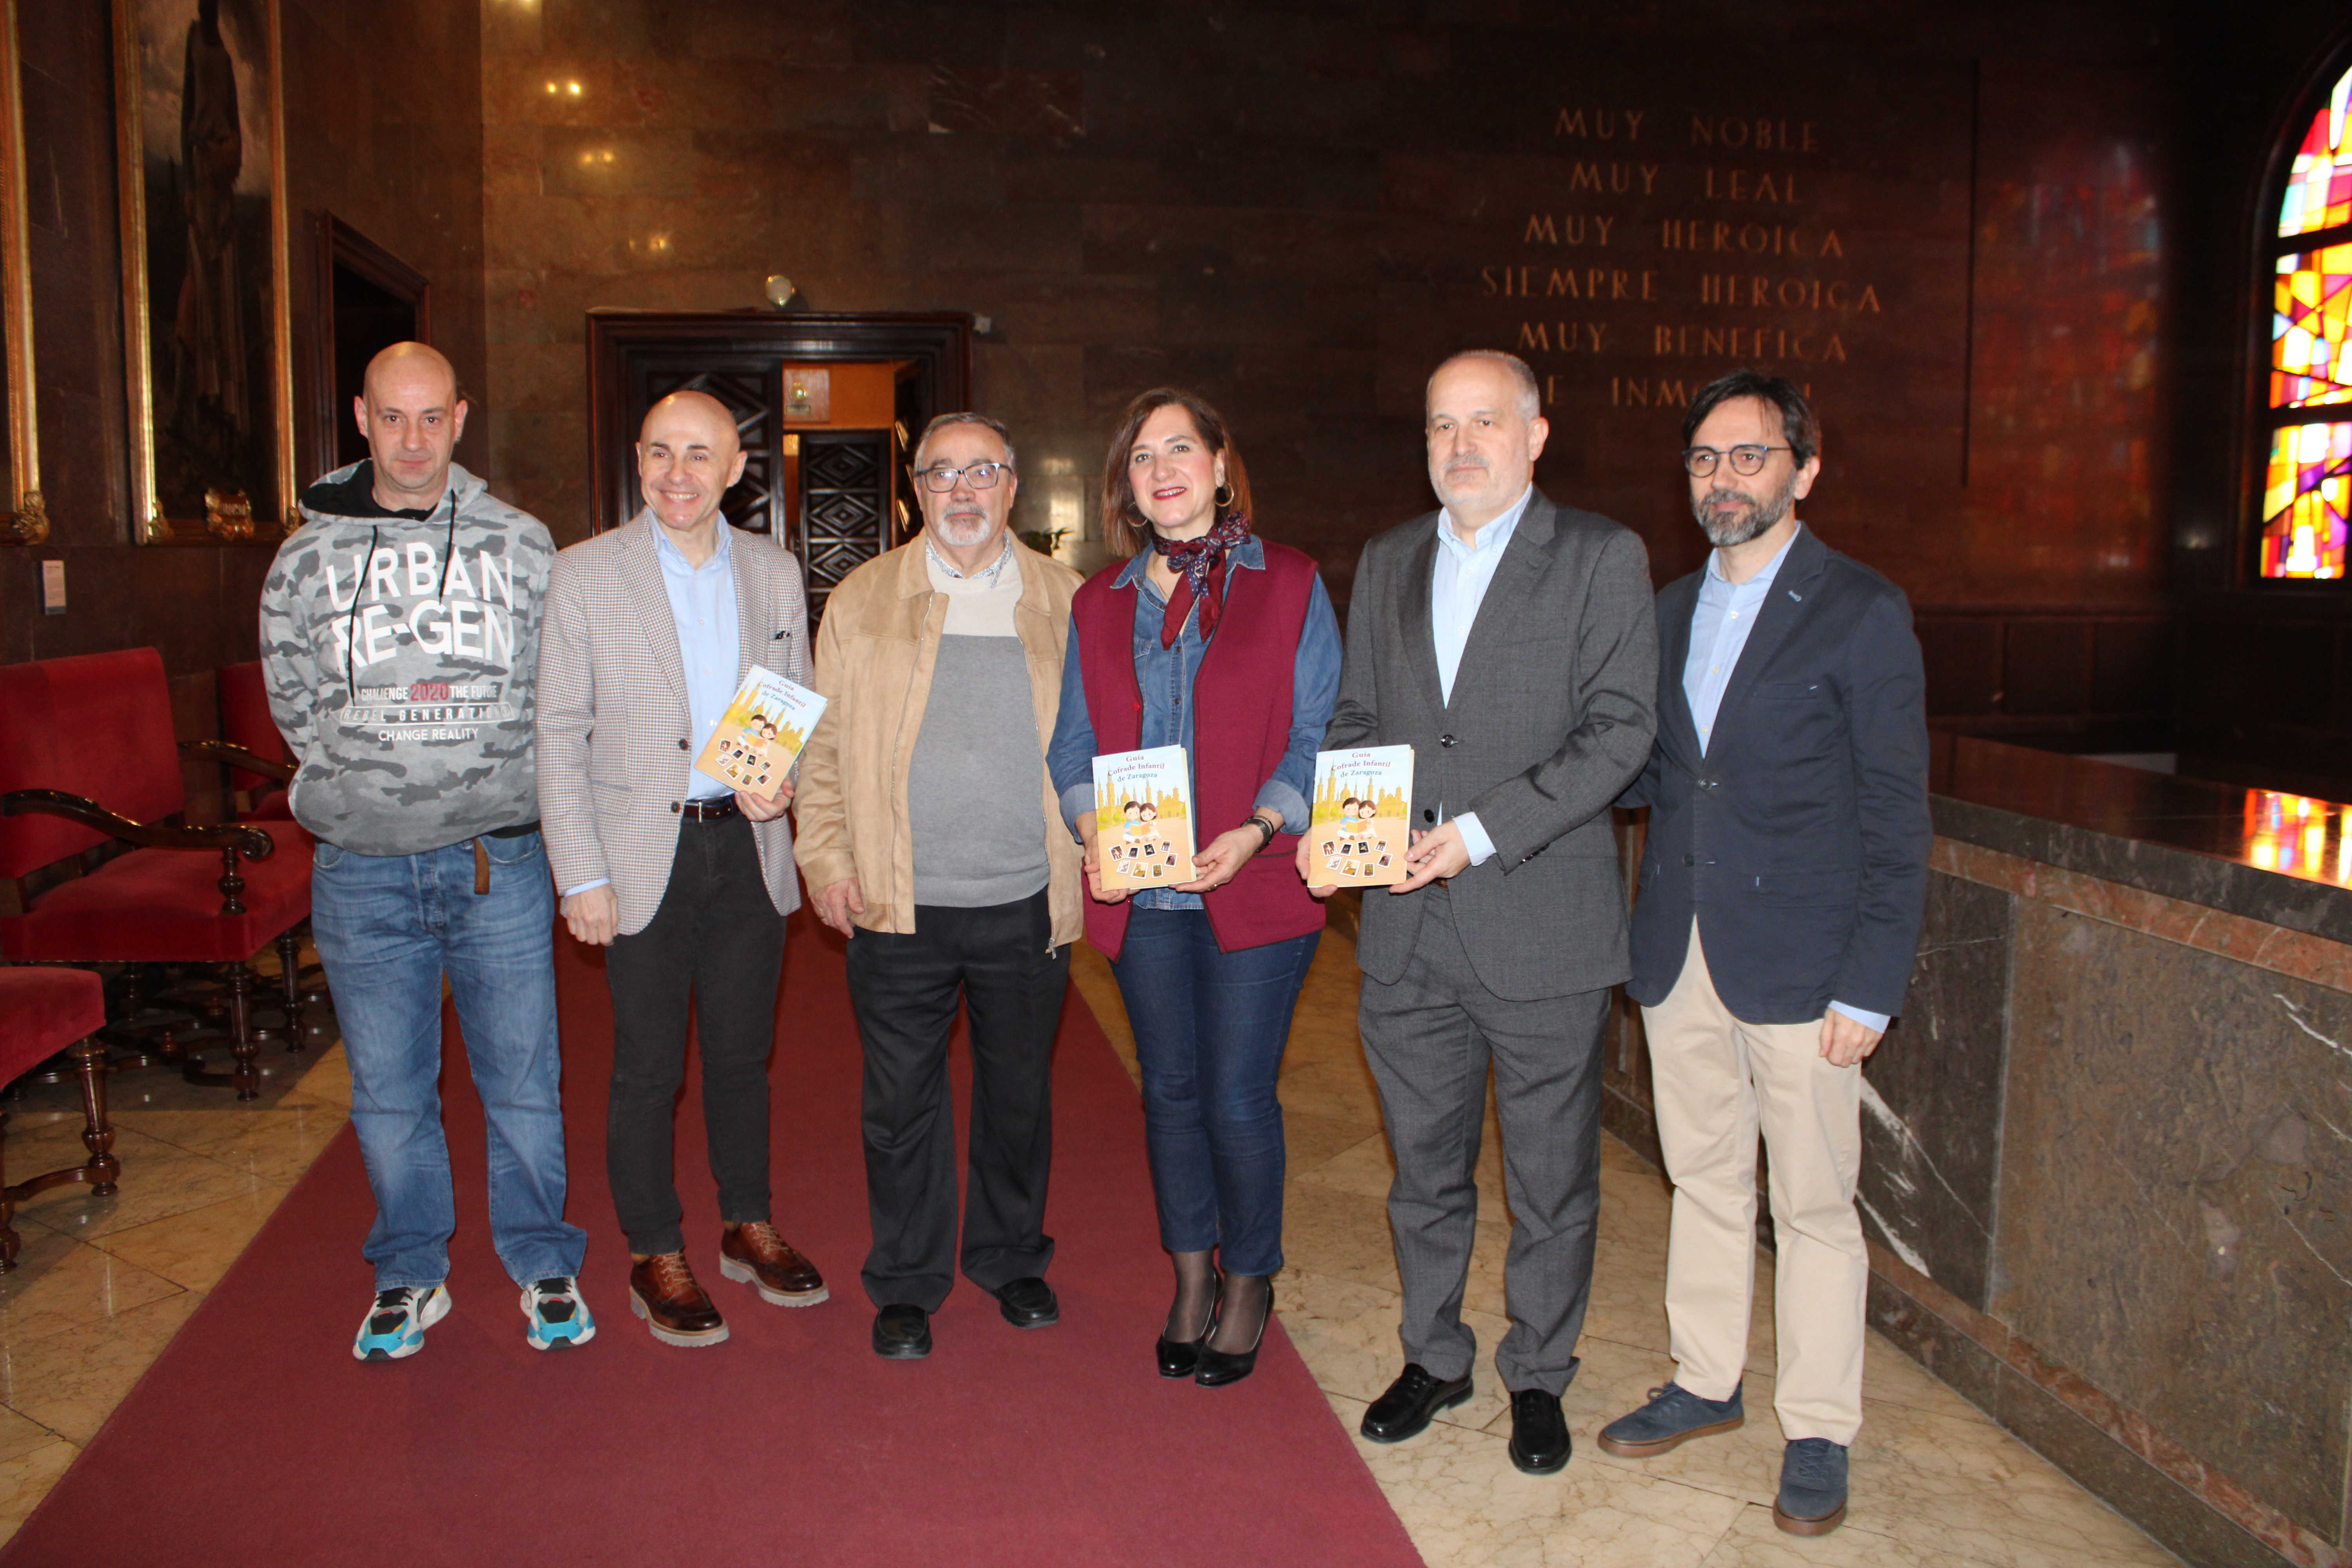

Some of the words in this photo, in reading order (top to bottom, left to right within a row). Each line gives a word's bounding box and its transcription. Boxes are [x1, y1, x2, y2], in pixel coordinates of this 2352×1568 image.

[1555, 107, 1644, 140] MUY
[1690, 116, 1819, 152] NOBLE
[1570, 162, 1658, 195] MUY
[1705, 168, 1804, 204] LEAL
[1524, 214, 1613, 246] MUY
[1662, 220, 1843, 258] HEROICA
[1482, 266, 1659, 300] SIEMPRE
[1701, 274, 1880, 313] HEROICA
[1518, 321, 1606, 351] MUY
[1654, 325, 1846, 361] BENEFICA
[326, 542, 513, 613] URBAN
[331, 599, 515, 676] RE-GEN
[360, 687, 409, 701] CHALLENGE
[410, 682, 448, 702] 2020
[450, 686, 470, 699] THE
[758, 682, 783, 693] Cofrade
[784, 691, 806, 708] Infantil
[770, 693, 795, 710] Zaragoza
[343, 709, 386, 722] REBEL
[399, 706, 500, 722] GENERATIO
[378, 729, 428, 742] CHANGE
[432, 728, 479, 740] REALITY
[1108, 764, 1136, 777] Cofrade
[1331, 761, 1361, 771] Cofrade
